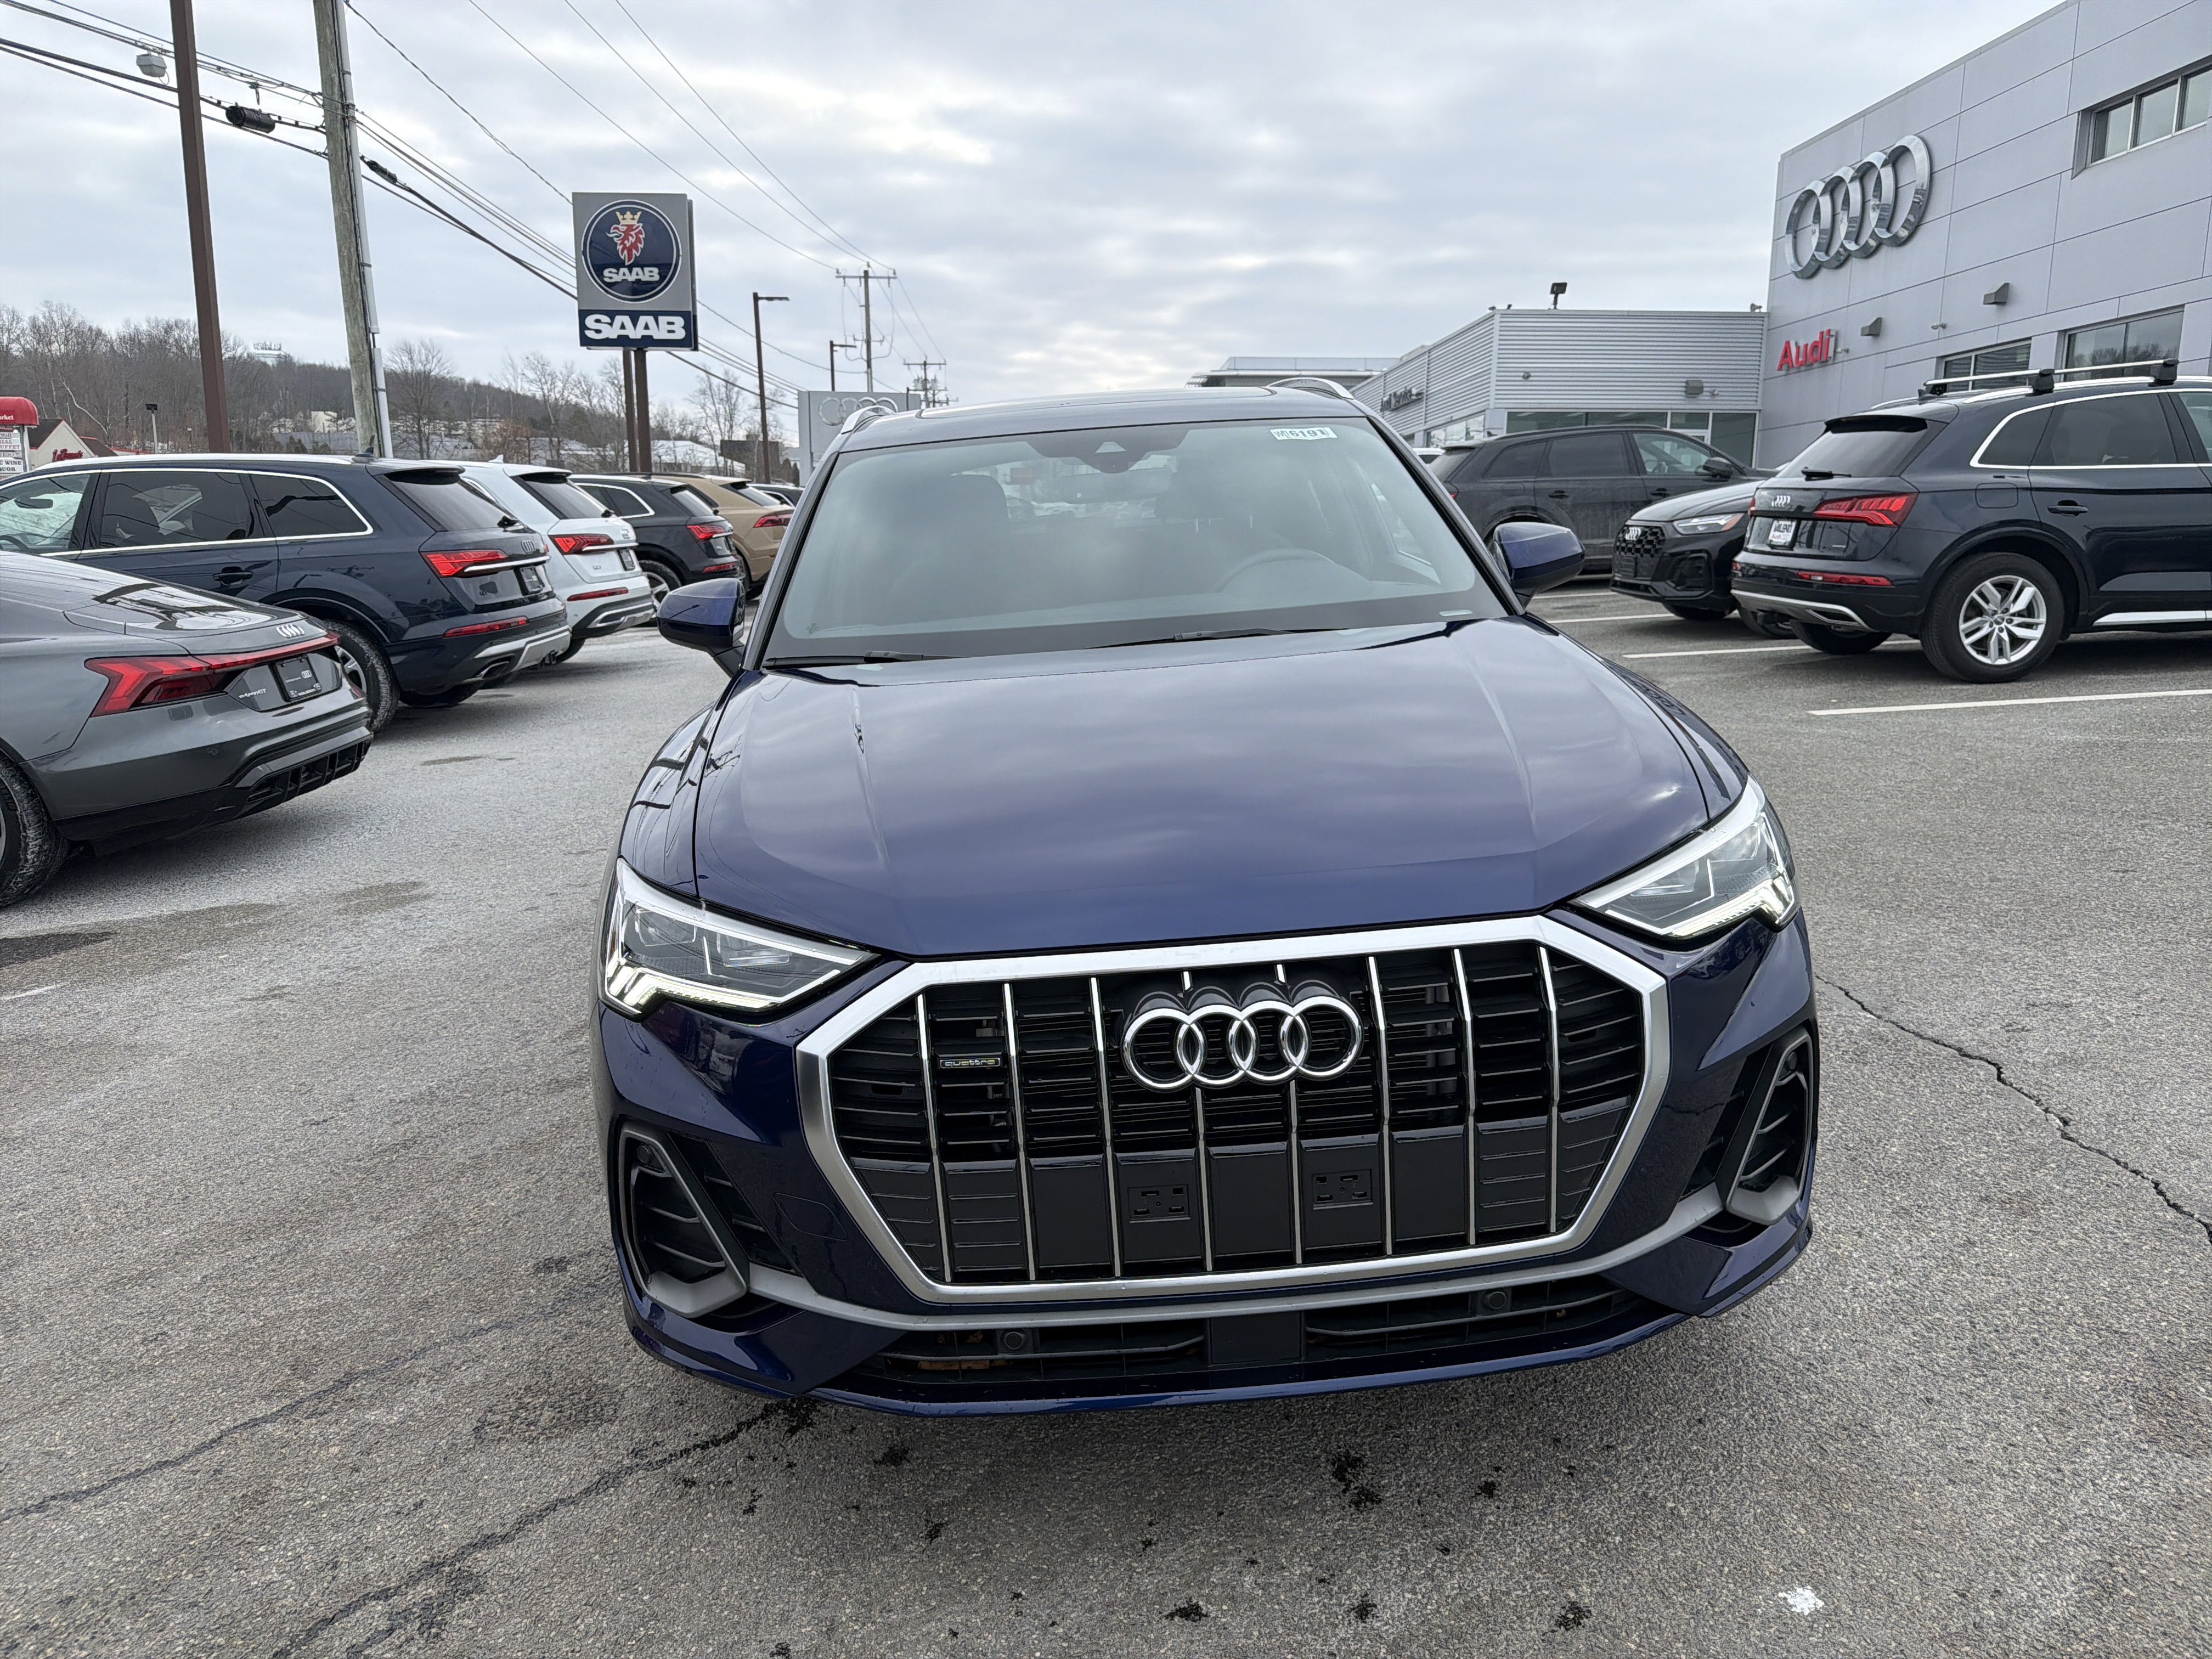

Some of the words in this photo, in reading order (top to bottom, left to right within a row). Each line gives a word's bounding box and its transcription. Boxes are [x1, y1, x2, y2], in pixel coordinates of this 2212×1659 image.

[603, 267, 660, 283] SAAB
[584, 314, 686, 340] SAAB
[1777, 329, 1831, 371] Audi
[944, 1059, 996, 1068] quattro
